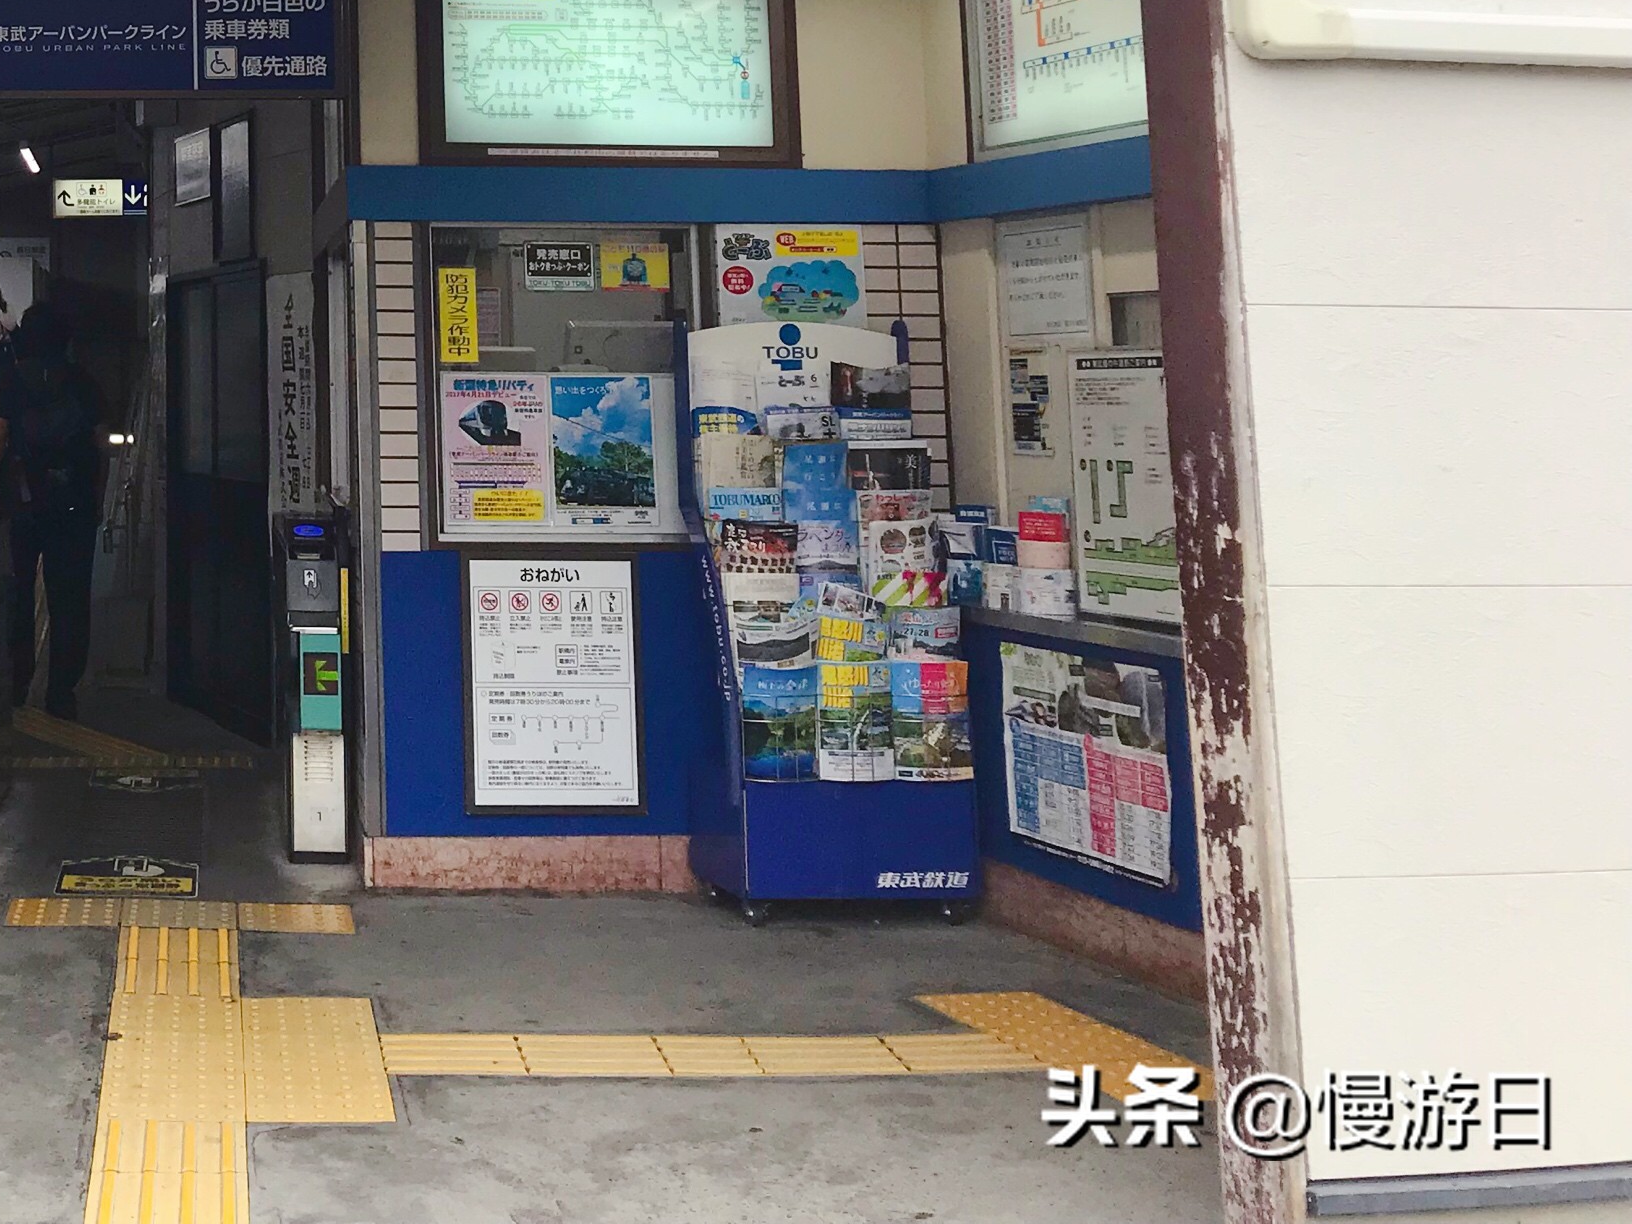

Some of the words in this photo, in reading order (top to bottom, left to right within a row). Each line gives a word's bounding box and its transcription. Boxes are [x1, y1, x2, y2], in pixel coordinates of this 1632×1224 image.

[204, 19, 290, 41] 乗車券類
[43, 44, 95, 53] URBAN
[103, 43, 143, 52] PARK
[151, 42, 187, 52] LINE
[241, 55, 328, 78] 優先通路
[536, 248, 581, 261] 発売窓口
[445, 272, 471, 357] 防犯カメラ作動中
[762, 346, 818, 360] TOBU
[821, 415, 836, 427] SL
[520, 567, 580, 583] おねがい
[317, 810, 323, 823] 1
[877, 871, 970, 890] 東武鉄道
